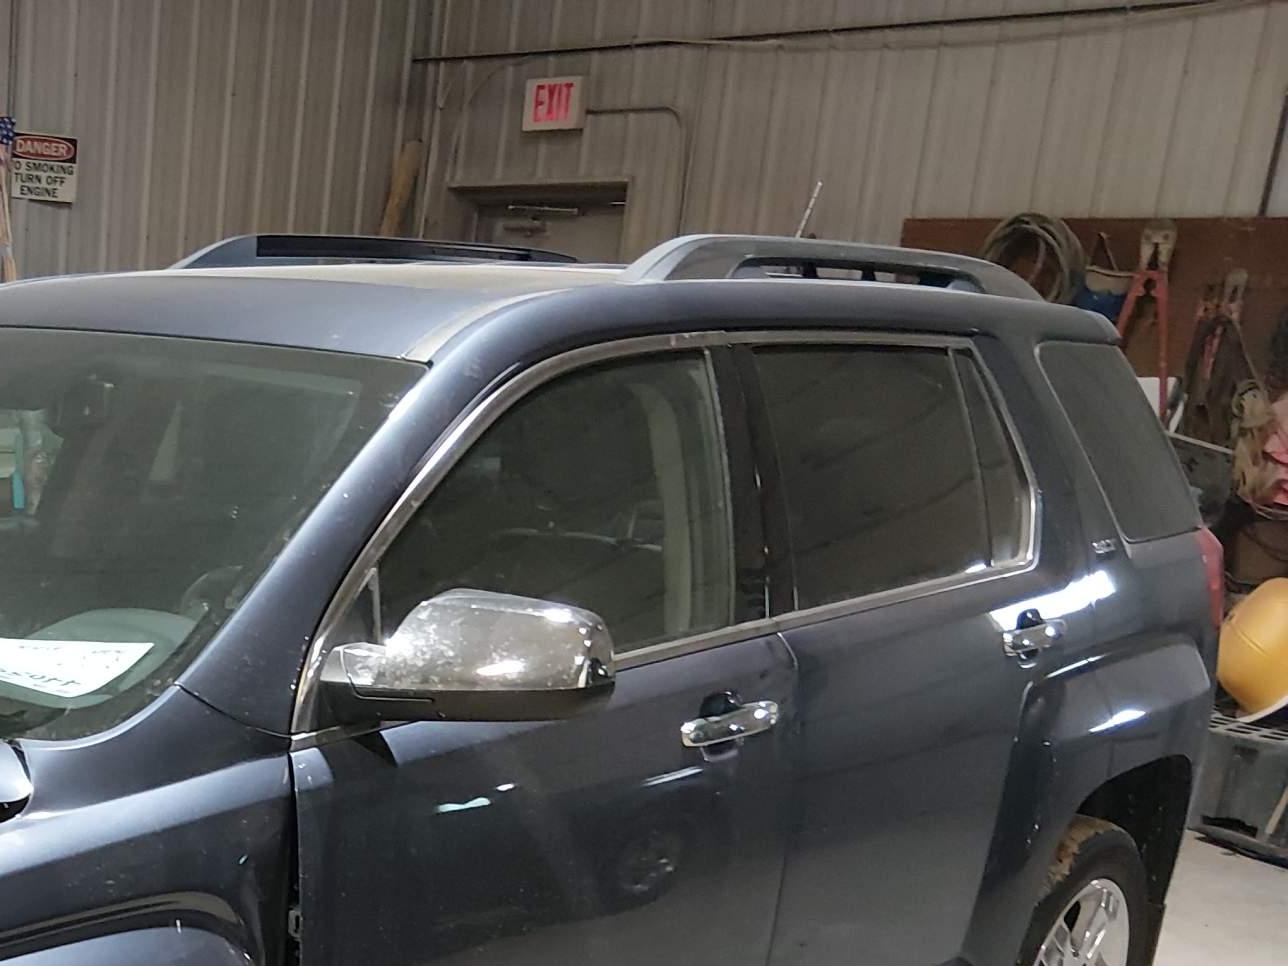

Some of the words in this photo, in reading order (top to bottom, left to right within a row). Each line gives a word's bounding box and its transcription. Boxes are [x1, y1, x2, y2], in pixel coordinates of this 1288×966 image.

[533, 82, 574, 123] EXIT
[16, 140, 68, 157] DANGER
[25, 161, 74, 176] SMOKING
[14, 172, 42, 184] TURN
[46, 175, 66, 187] OFF
[19, 185, 59, 199] ENGINE
